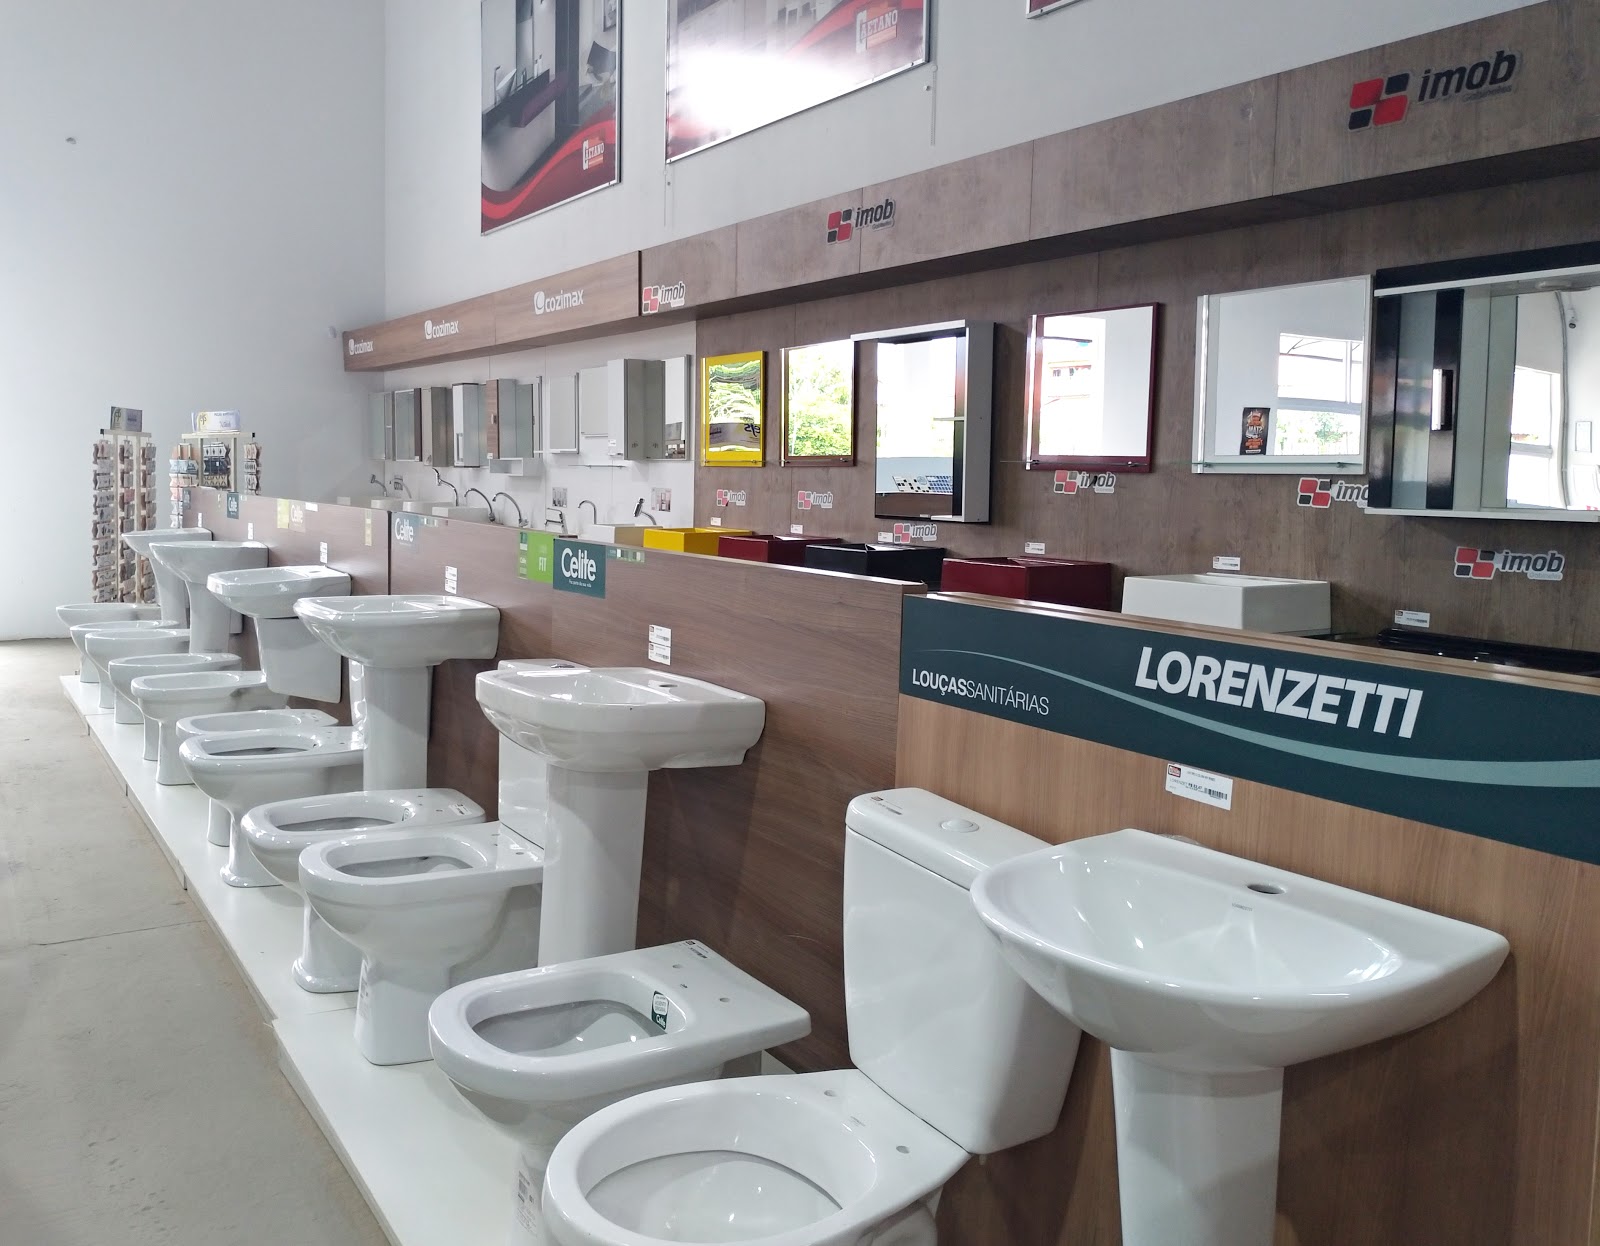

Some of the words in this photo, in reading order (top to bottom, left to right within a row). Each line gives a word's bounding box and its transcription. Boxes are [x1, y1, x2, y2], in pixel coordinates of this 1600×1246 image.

[1418, 50, 1517, 102] imob
[855, 198, 894, 228] imob
[545, 290, 584, 312] cozimax
[661, 282, 685, 303] imob
[433, 320, 459, 338] cozimax
[355, 340, 373, 354] cozimax
[730, 490, 746, 502] imob
[812, 492, 833, 504] imob
[395, 517, 414, 542] Celite
[912, 524, 937, 537] imob
[561, 547, 597, 582] Celite
[1501, 551, 1564, 572] imob
[1135, 646, 1424, 739] LORENZETTI
